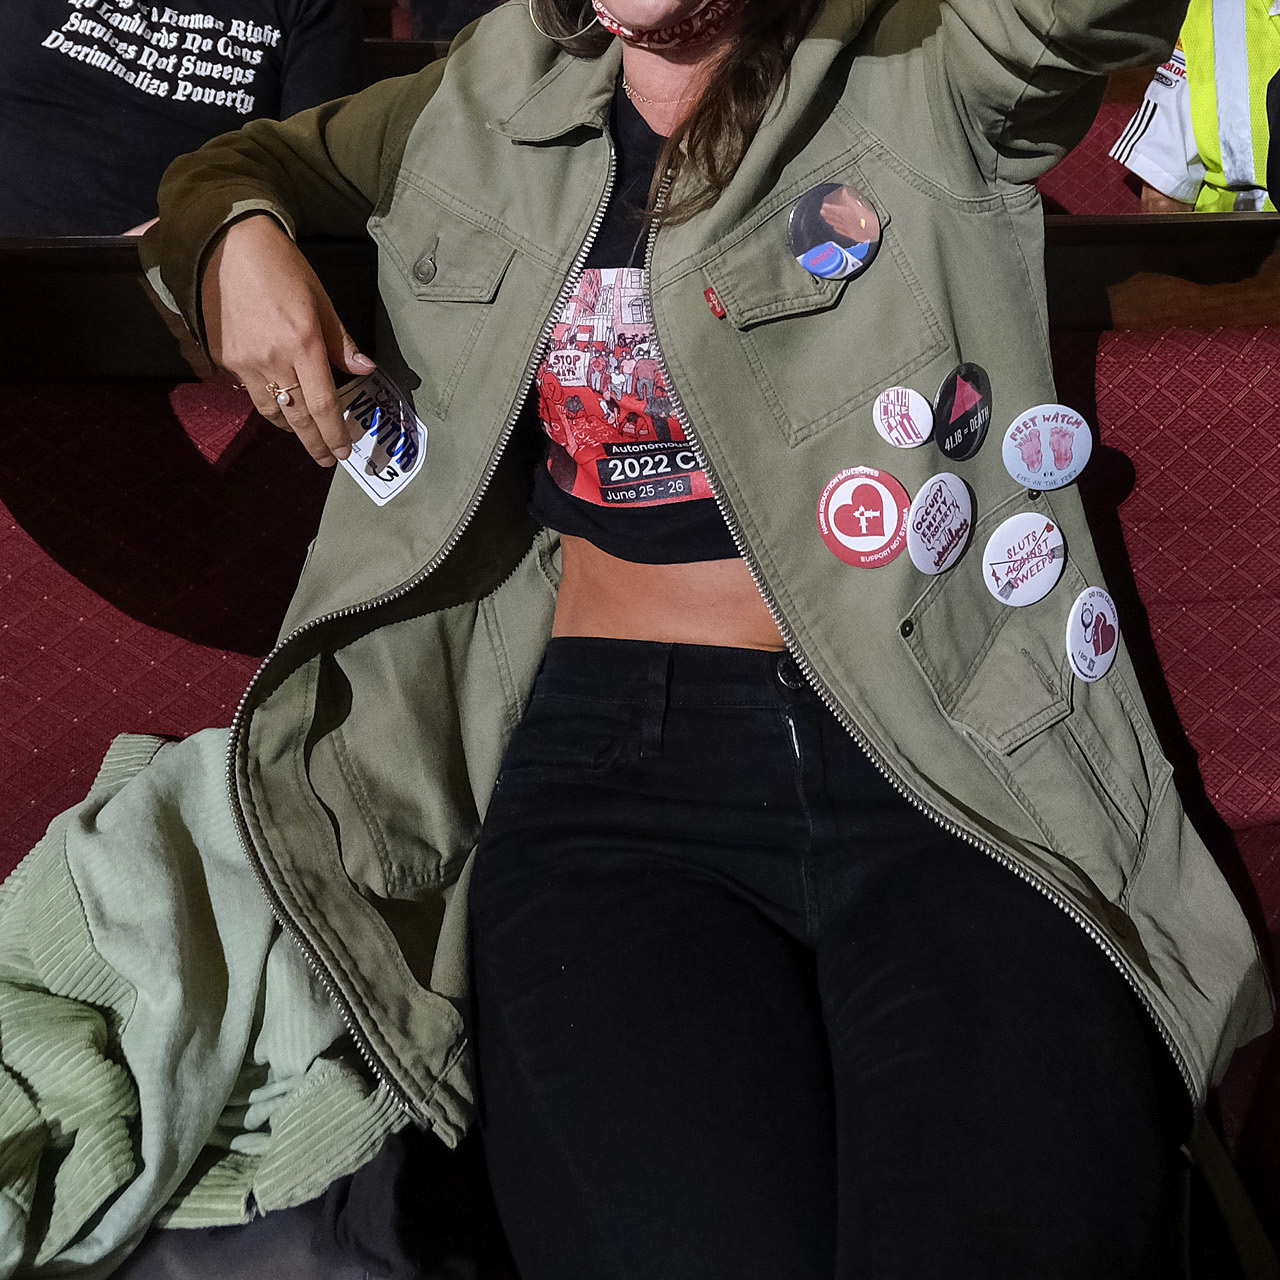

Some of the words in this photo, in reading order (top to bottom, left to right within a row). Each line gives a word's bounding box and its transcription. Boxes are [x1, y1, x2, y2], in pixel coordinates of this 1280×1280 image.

[96, 2, 180, 50] Landlords
[182, 32, 213, 54] No
[227, 19, 281, 48] Right
[62, 12, 138, 60] Services
[137, 46, 178, 73] Not
[178, 55, 256, 85] Sweeps
[41, 30, 170, 98] Decriminalize
[172, 80, 256, 115] Poverty
[553, 355, 581, 366] STOP
[880, 389, 909, 406] HEALTH
[880, 402, 909, 419] CARE
[346, 390, 418, 471] VISITOR
[945, 429, 962, 451] 41.18
[969, 406, 990, 432] DEATH
[1010, 416, 1037, 441] FEET
[1043, 412, 1084, 428] WATCH
[609, 455, 672, 481] 2022
[607, 489, 636, 500] June
[639, 484, 655, 497] 25
[668, 480, 684, 493] 26
[916, 484, 942, 531] OCCUPY
[921, 497, 947, 539] EMPTY
[927, 500, 957, 544] PROPERTY
[1005, 537, 1049, 577] AGAINST
[1006, 530, 1037, 559] SLUTS
[1013, 552, 1054, 589] SWEEPS
